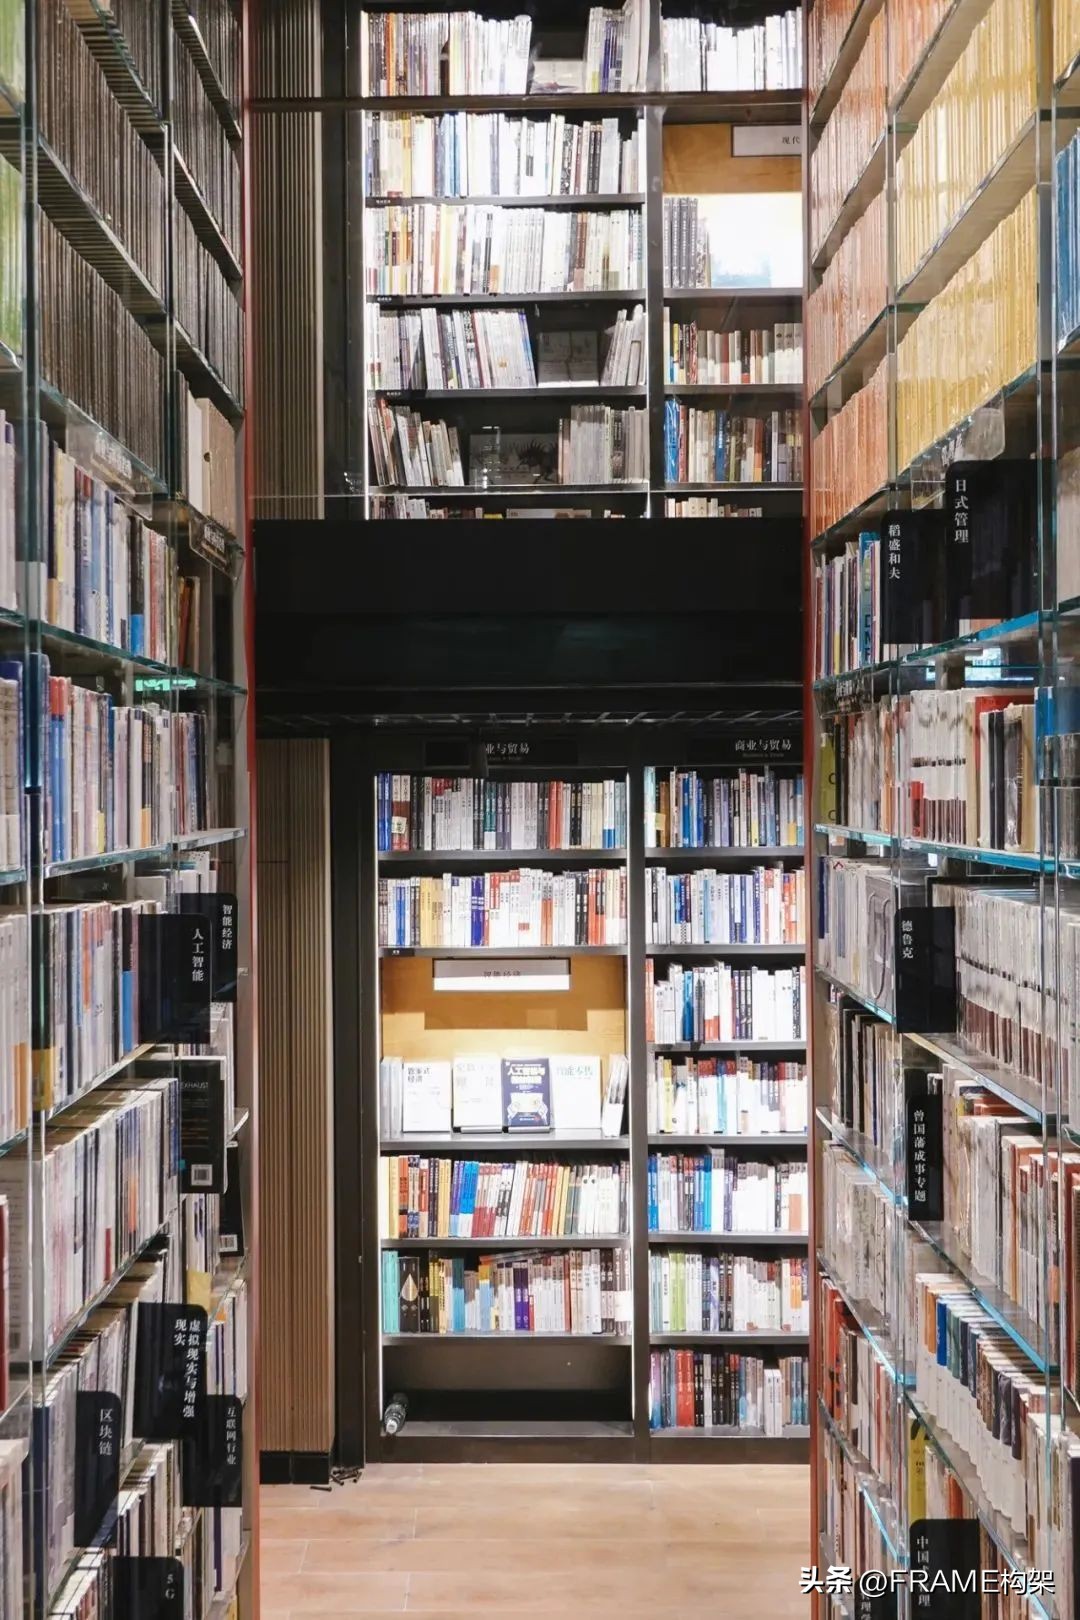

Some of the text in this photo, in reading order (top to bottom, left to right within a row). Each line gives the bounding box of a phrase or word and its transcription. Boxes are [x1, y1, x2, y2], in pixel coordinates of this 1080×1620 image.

[954, 479, 969, 543] 日式管理
[889, 524, 901, 580] 稻盛和夫
[485, 742, 530, 755] 业与贸易
[735, 739, 792, 751] 商业与贸易
[222, 904, 233, 950] 智能经济
[902, 919, 914, 959] 德鲁克
[192, 928, 205, 982] 人工智能
[914, 1109, 926, 1202] 曾国藩成事专题
[174, 1318, 187, 1346] 现实
[183, 1319, 200, 1418] 虚拟现实与增强
[99, 1408, 113, 1456] 区块链
[226, 1406, 237, 1466] 互联网行业
[165, 1573, 176, 1600] 5G
